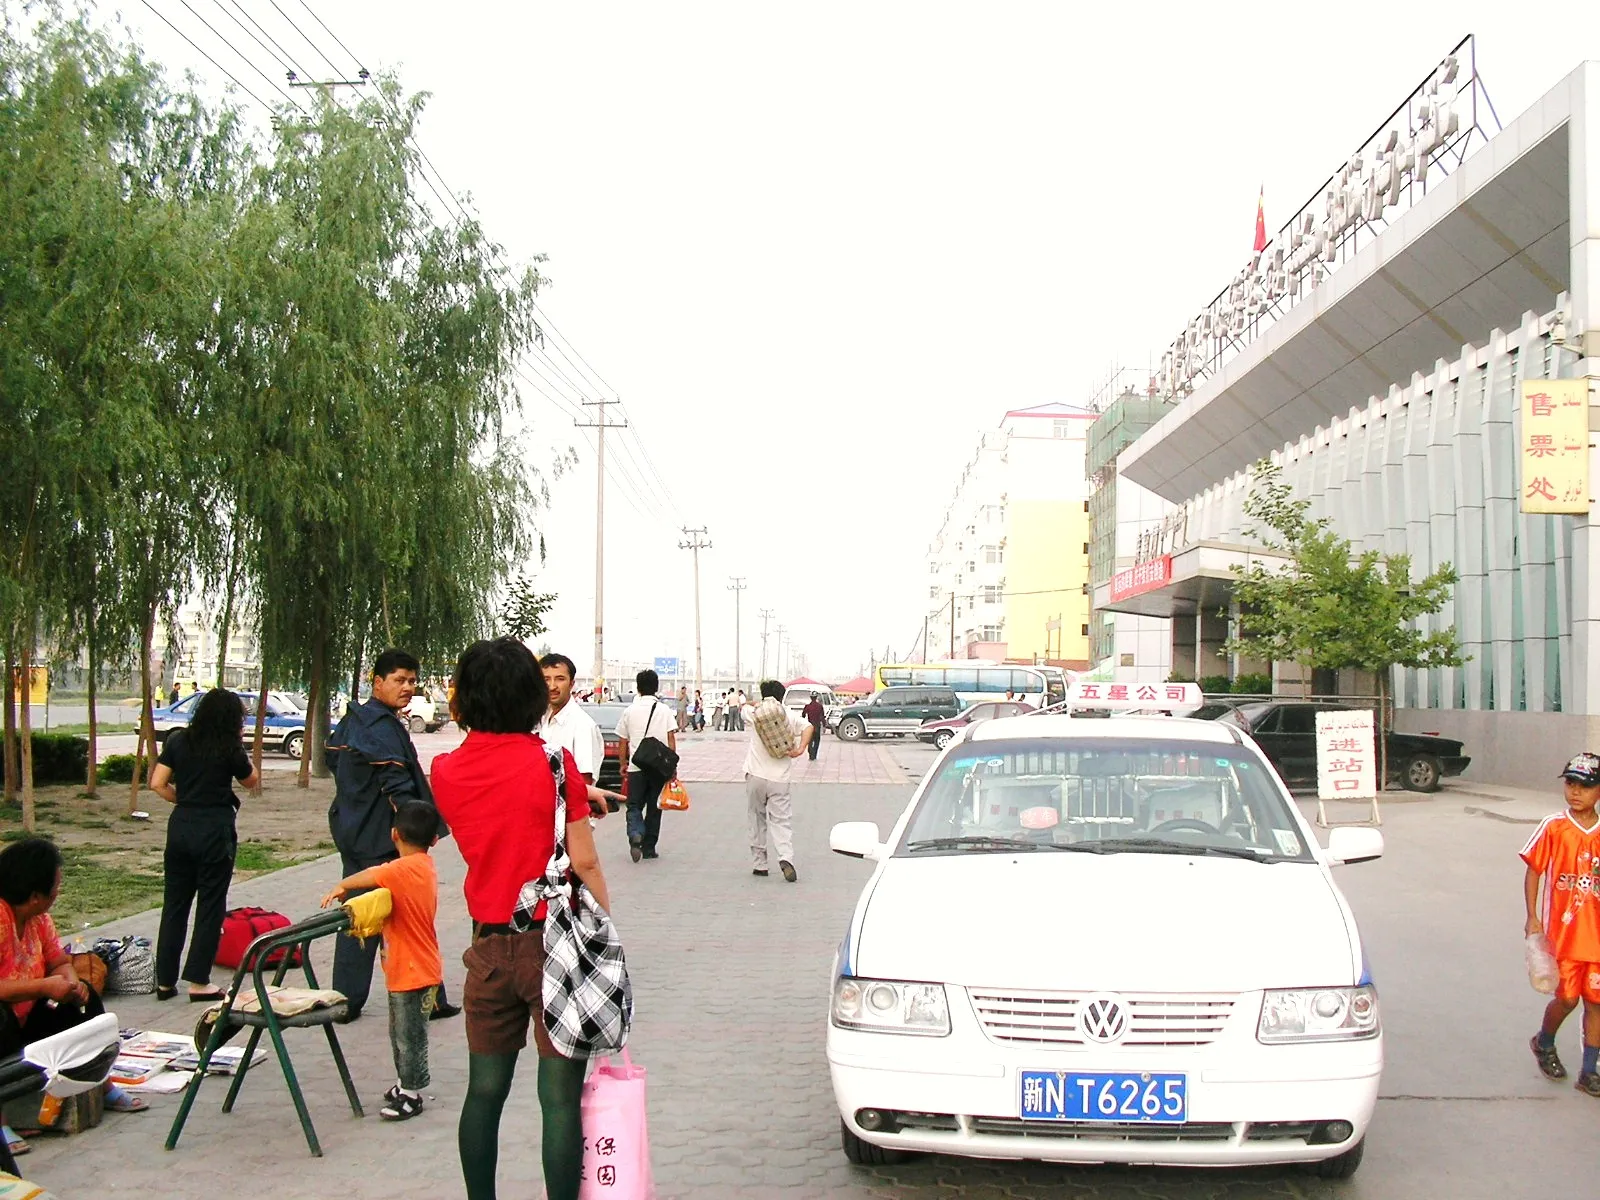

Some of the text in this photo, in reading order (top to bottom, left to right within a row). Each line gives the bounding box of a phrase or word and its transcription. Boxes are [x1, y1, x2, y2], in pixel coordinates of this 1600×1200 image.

[1525, 392, 1557, 501] 售票处
[1079, 684, 1186, 702] 五星公司
[1327, 738, 1364, 791] 进站口
[1024, 1077, 1183, 1116] 新N T6265
